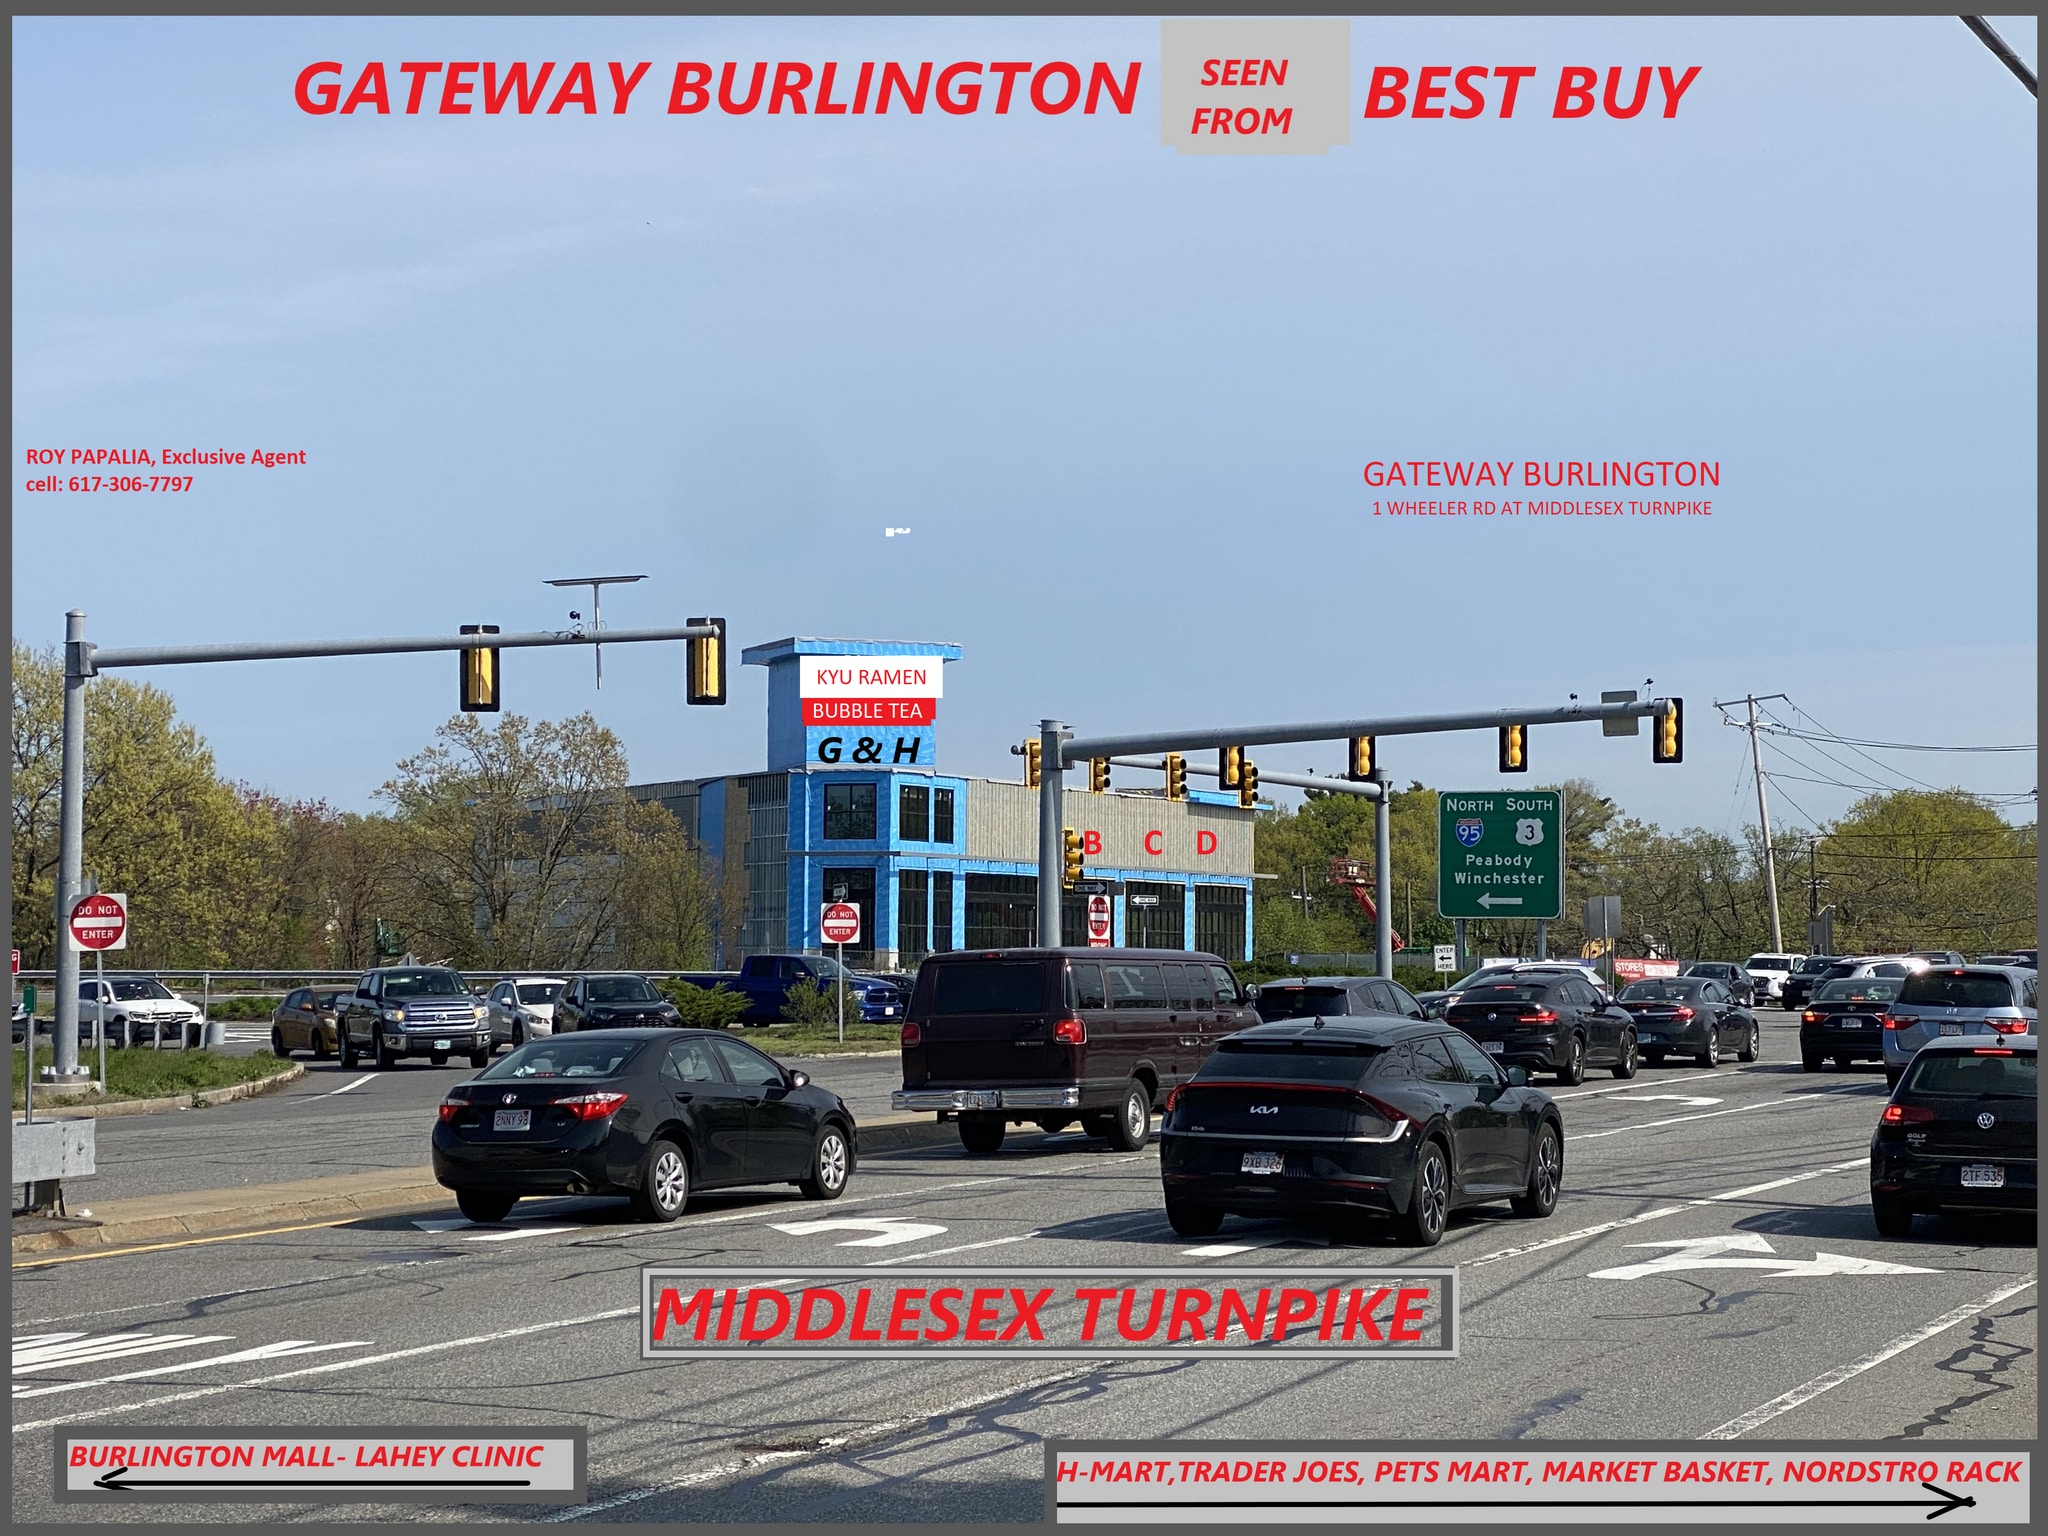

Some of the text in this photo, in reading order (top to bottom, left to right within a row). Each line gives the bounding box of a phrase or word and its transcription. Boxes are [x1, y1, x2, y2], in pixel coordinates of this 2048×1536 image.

[1446, 797, 1553, 812] NORTH SOUTH
[1459, 825, 1480, 841] 95
[1524, 824, 1535, 840] 3
[1466, 854, 1533, 869] Peabody
[1454, 872, 1545, 885] Winchester
[78, 905, 118, 916] DO NOT
[82, 929, 114, 939] ENTER
[829, 927, 851, 935] ENTER
[1615, 961, 1644, 972] STORES
[1243, 1157, 1261, 1169] 9XB
